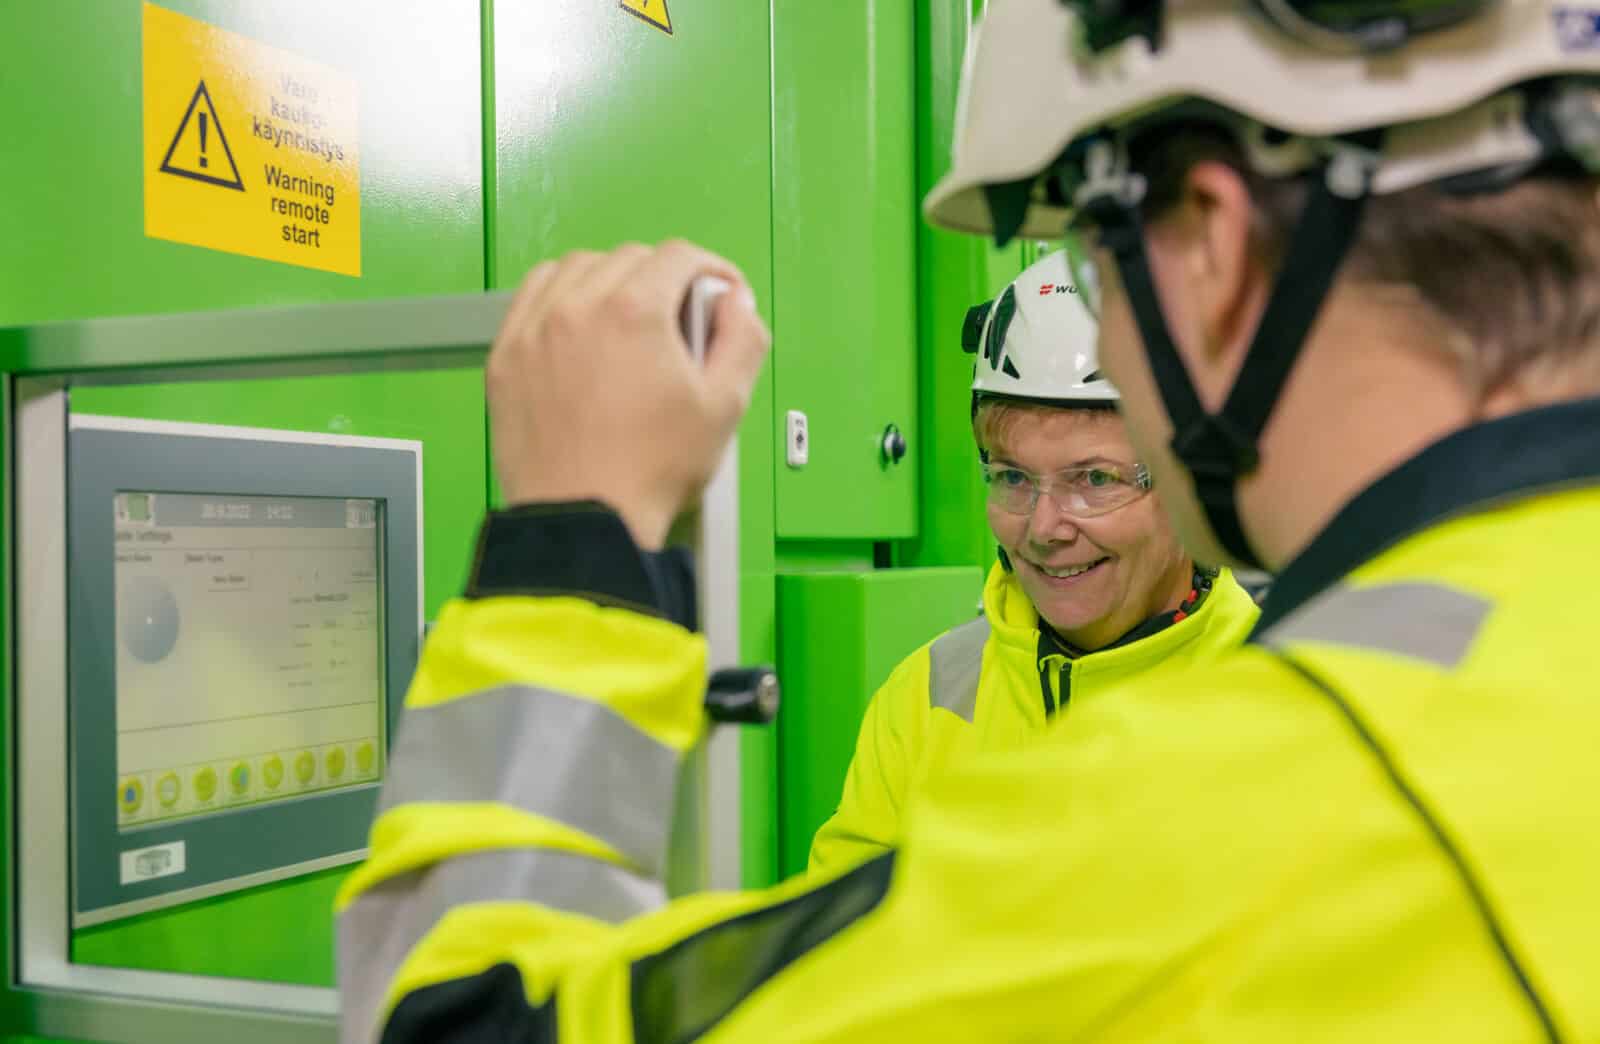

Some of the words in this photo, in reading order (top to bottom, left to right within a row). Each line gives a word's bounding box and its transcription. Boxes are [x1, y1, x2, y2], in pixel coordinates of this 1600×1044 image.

[252, 116, 345, 162] käynnistys
[264, 165, 335, 206] Warning
[271, 197, 329, 224] remote
[282, 225, 320, 248] start
